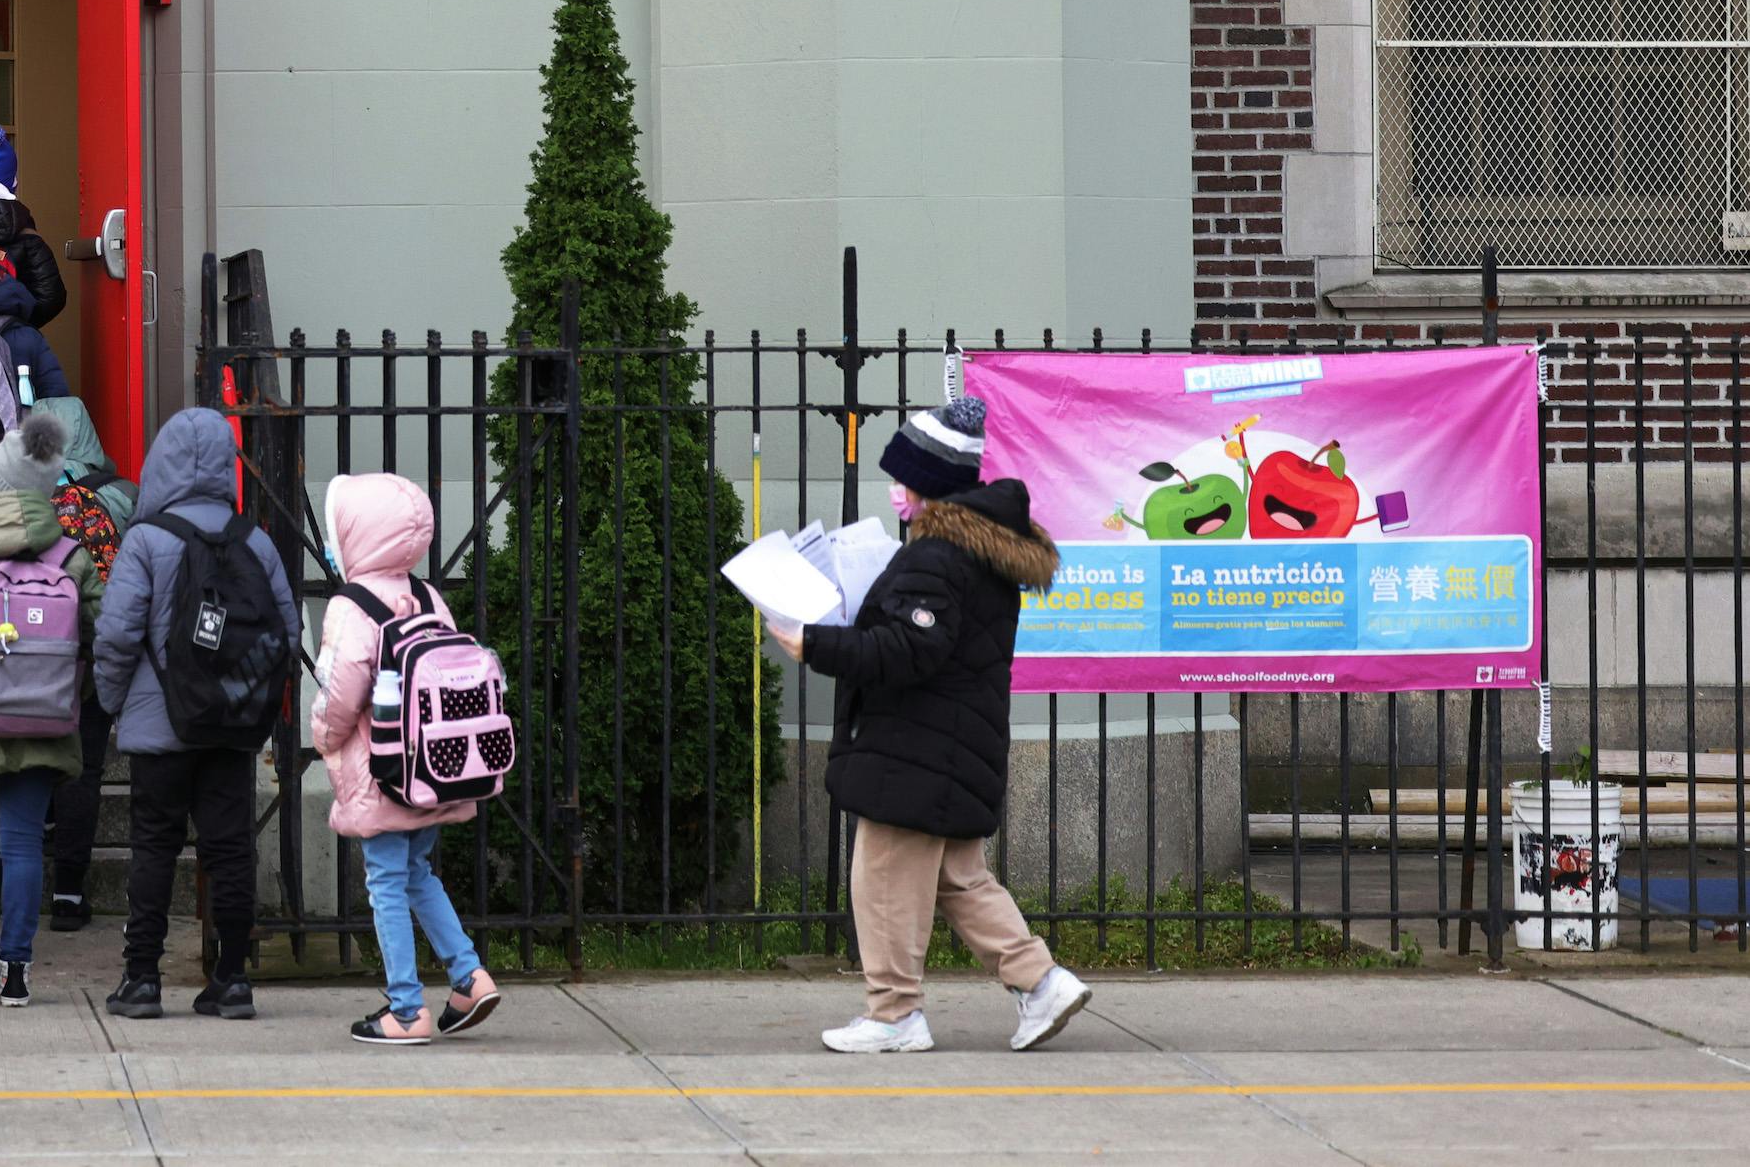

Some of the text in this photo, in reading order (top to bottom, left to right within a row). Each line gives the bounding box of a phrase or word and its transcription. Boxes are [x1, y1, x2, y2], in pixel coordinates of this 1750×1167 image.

[1214, 374, 1251, 388] YOUR
[1252, 359, 1321, 384] MIND
[1053, 563, 1145, 585] ition is
[1172, 562, 1345, 585] La nutrición
[1368, 564, 1516, 602] 營養無價
[1020, 587, 1145, 610] riceless
[1172, 586, 1345, 608] no tiene precio
[202, 611, 221, 625] NETS
[1180, 671, 1335, 683] www.schoolfoodnyc.org
